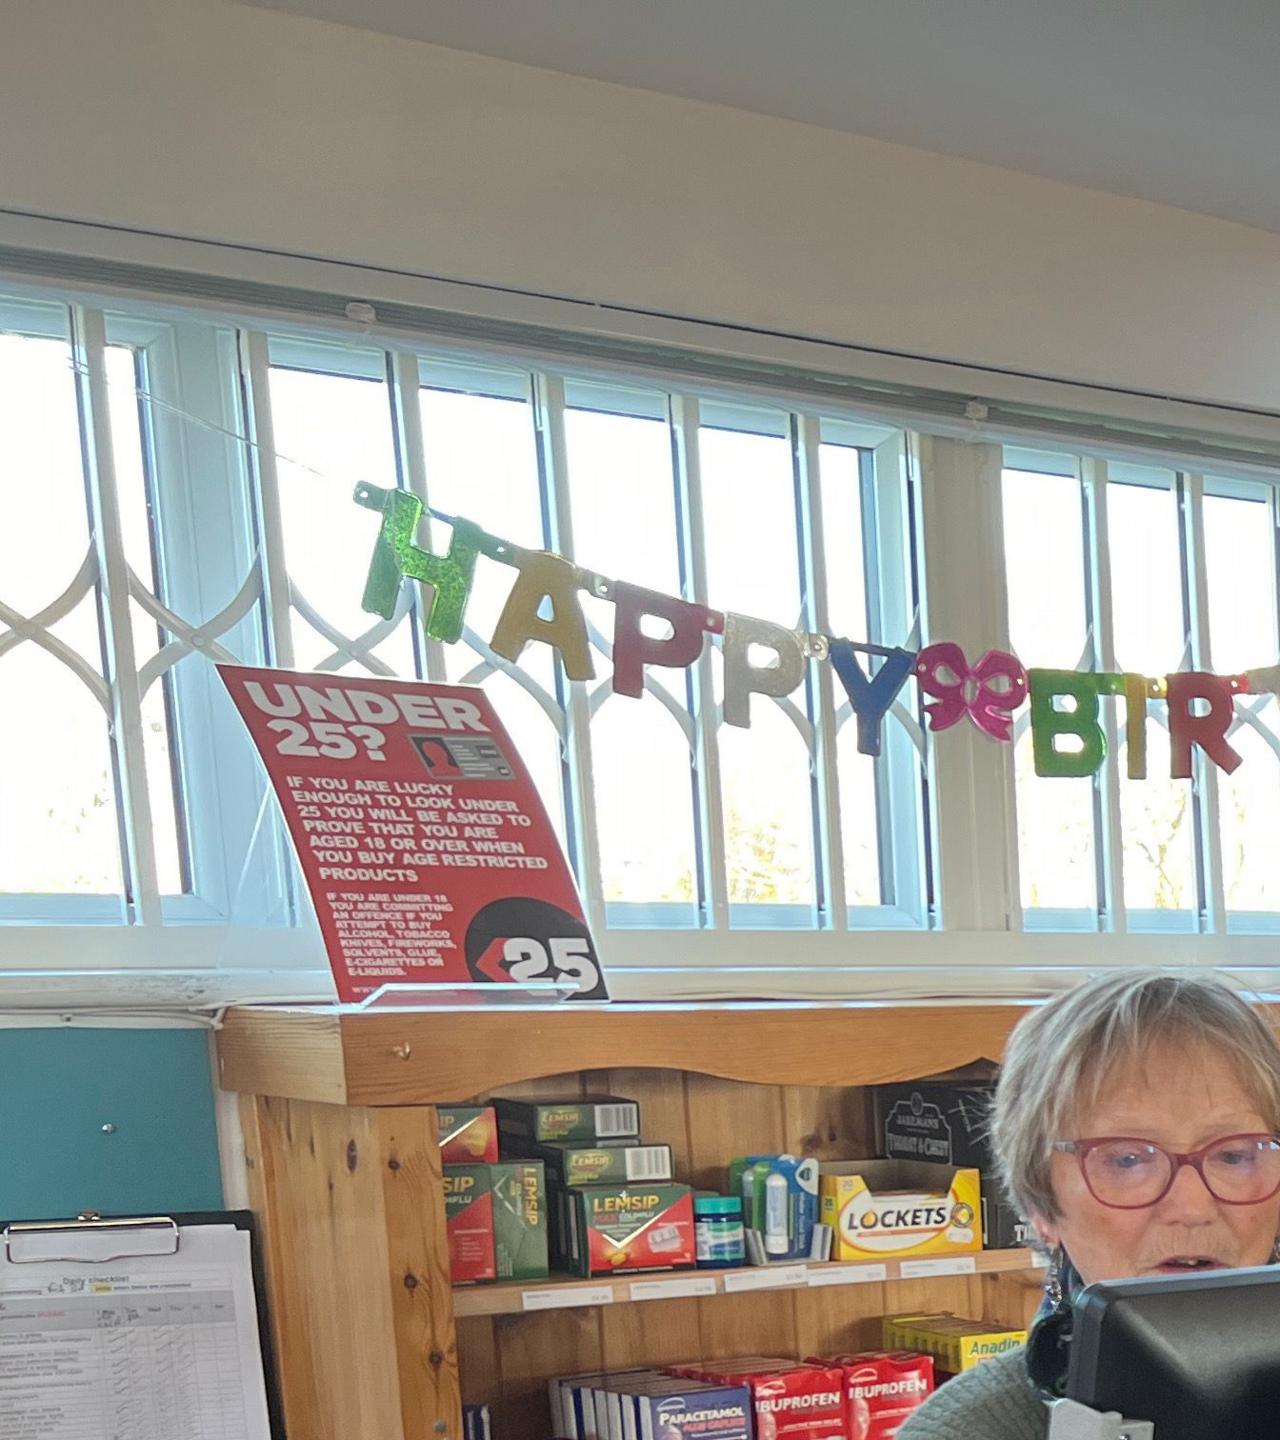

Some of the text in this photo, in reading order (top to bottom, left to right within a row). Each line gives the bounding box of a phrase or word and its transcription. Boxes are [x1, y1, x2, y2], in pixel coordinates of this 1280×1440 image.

[360, 487, 916, 757] HAPPY
[242, 681, 492, 732] UNDER
[266, 719, 386, 761] 25?
[286, 775, 454, 796] IF YOU ARE LUCKY
[291, 790, 520, 813] ENOUGH TO LOOK UNDER
[299, 805, 532, 828] 25 YOU WILL BE ASKED TO
[303, 820, 498, 840] PROVE THAT YOU ARE
[310, 836, 525, 855] AGED 18 OR OVER WHEN
[313, 850, 548, 870] YOU BUY AGE RESTRICTED
[319, 867, 419, 883] PRODUCTS
[352, 911, 403, 921] OFFENCE
[382, 903, 453, 913] COMMITTING
[336, 920, 387, 930] ATTEMPT
[398, 929, 450, 939] TOBACCO
[503, 937, 599, 996] 25
[523, 1167, 539, 1226] LEMSIP
[593, 1195, 660, 1213] LEMSIP
[848, 1206, 947, 1231] LOCKETS
[970, 1336, 1021, 1356] Anadin
[849, 1378, 927, 1400] IBUPROFEN
[755, 1391, 840, 1414] IBUPROFEN
[659, 1406, 745, 1426] PARACETAMOL
